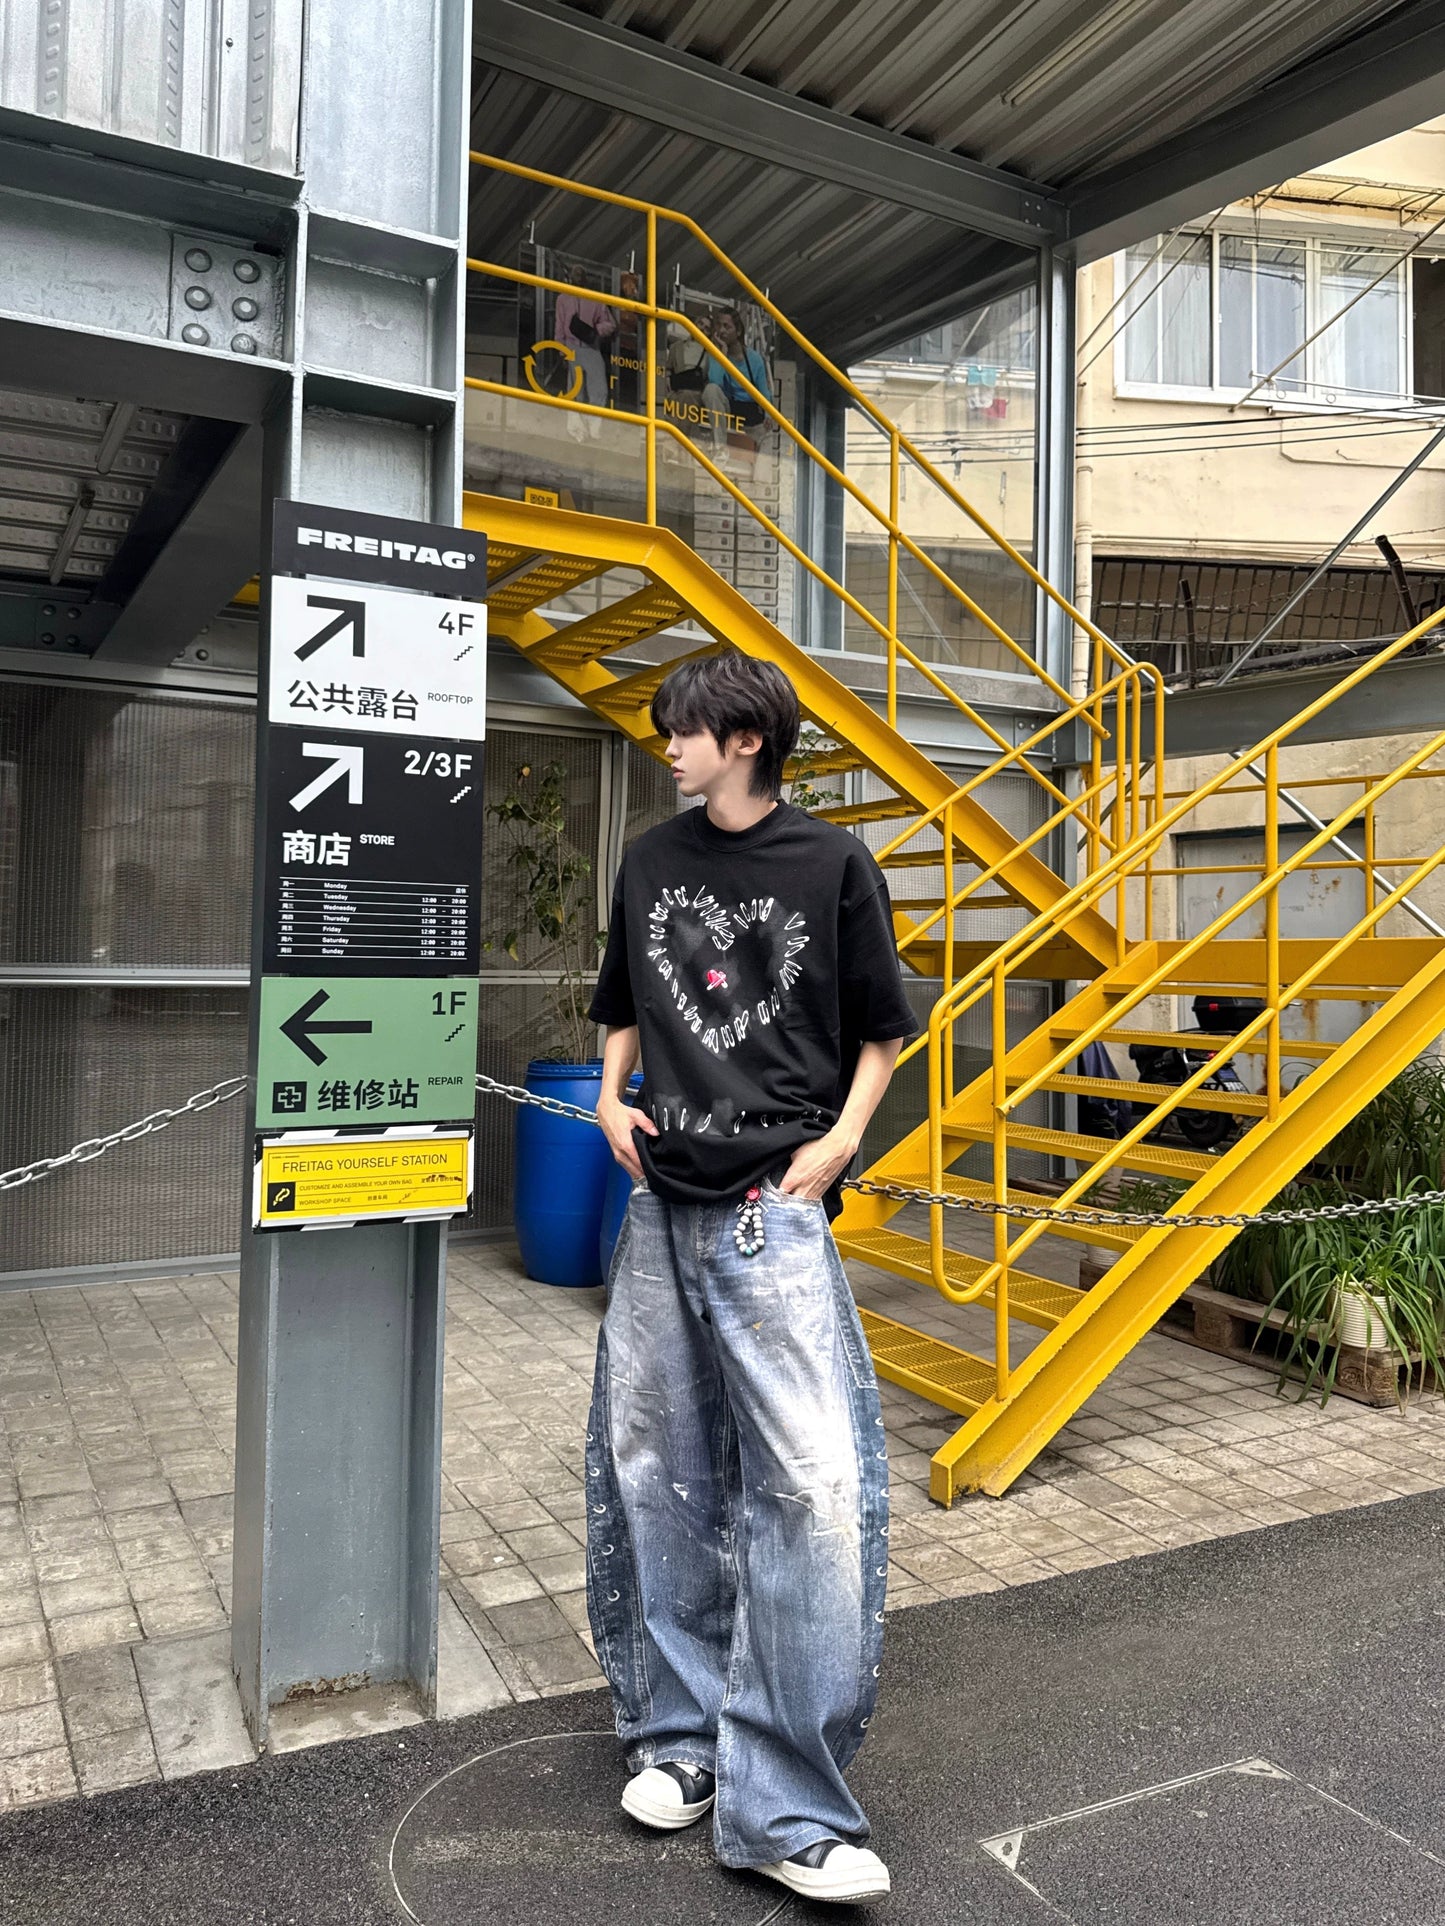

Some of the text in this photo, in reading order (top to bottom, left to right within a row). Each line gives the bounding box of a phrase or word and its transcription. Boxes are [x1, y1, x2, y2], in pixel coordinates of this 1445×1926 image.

[663, 398, 746, 434] MUSETTE
[438, 612, 474, 636] 4F
[287, 680, 419, 721] 公共露台
[427, 692, 473, 705] ROOFTOP
[404, 750, 472, 778] 2/3F
[282, 830, 351, 866] 商店
[360, 834, 395, 845] STORE
[324, 882, 347, 890] Monday
[323, 904, 356, 912] Wednesday
[432, 991, 467, 1015] 1F
[428, 1076, 463, 1086] REPAIR
[318, 1078, 419, 1111] 维修站
[282, 1154, 447, 1172] FREITAG YOURSELF STATION
[300, 1183, 331, 1191] CUSTOMIZE
[299, 1198, 331, 1206] WORKSHOP
